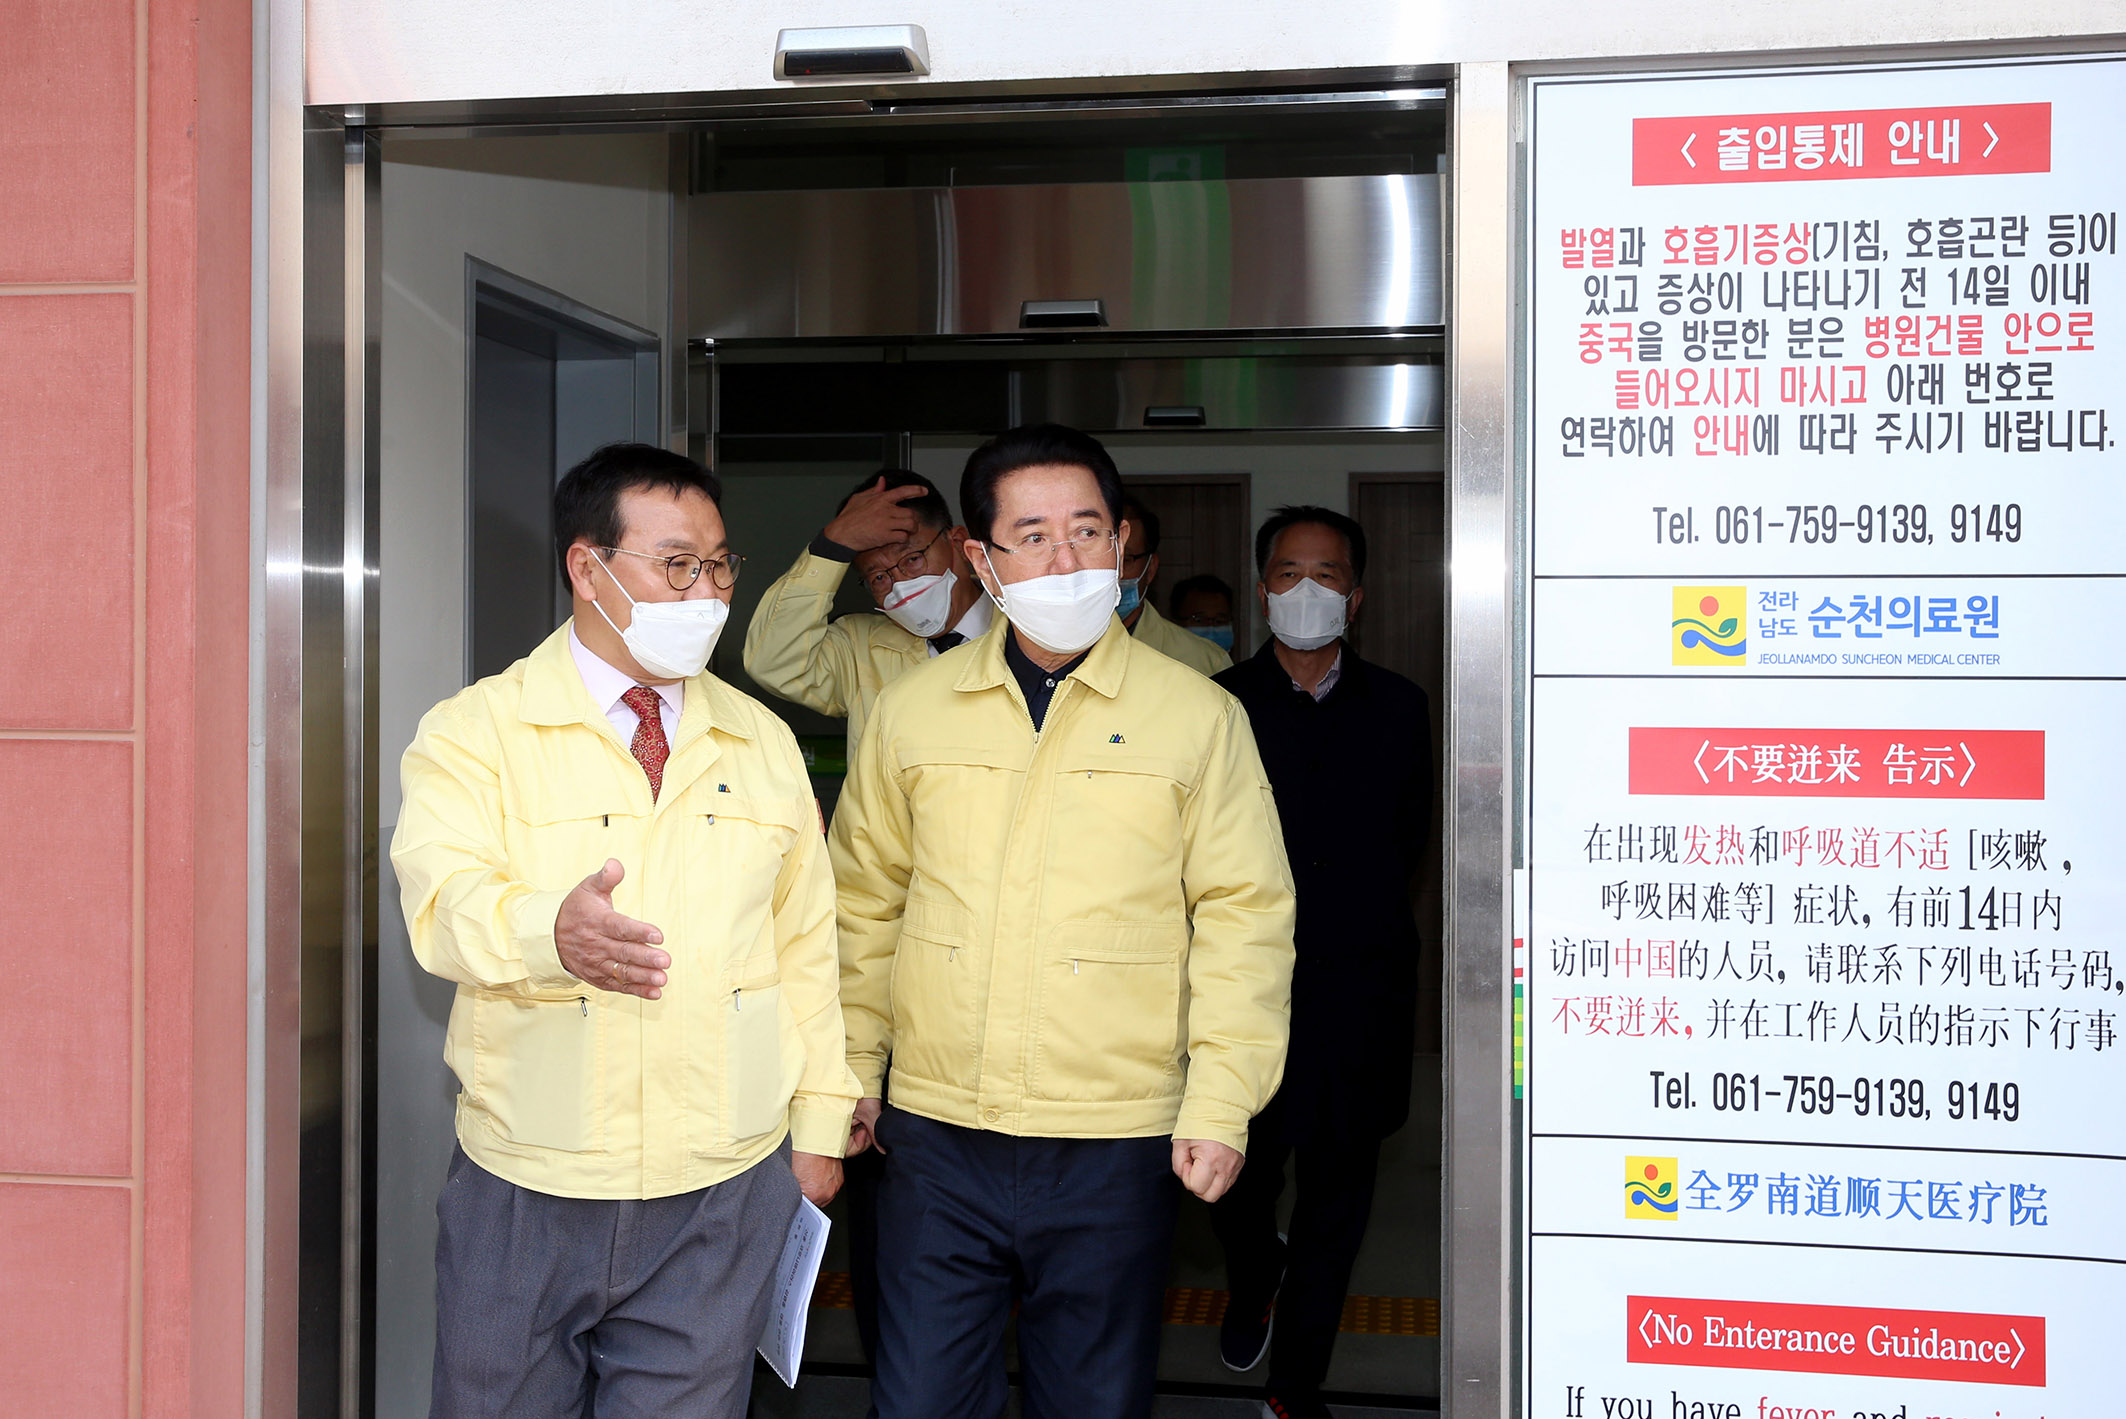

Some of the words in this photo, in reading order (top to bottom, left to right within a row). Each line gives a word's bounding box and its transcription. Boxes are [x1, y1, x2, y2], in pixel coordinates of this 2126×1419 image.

[1717, 122, 1864, 171] 출입통제
[1888, 118, 1960, 165] 안내
[1561, 226, 1646, 269] 발열과
[1905, 214, 2030, 260] 호흡곤란
[1584, 275, 1638, 316] 있고
[1658, 272, 1742, 315] 증상이
[1764, 268, 1879, 312] 나타나기
[1900, 267, 1925, 308] 전
[1948, 265, 2009, 306] 14일
[2031, 262, 2089, 305] 이내
[1579, 321, 1663, 364] 중국을
[1683, 319, 1769, 362] 방문한
[1788, 317, 1844, 358] 분은
[1865, 315, 1983, 358] 병원건물
[2004, 312, 2094, 352] 안으로
[1615, 367, 1759, 409] 들어오시지
[1781, 366, 1866, 407] 마시고
[1887, 363, 1943, 405] 아래
[1966, 362, 2053, 404] 번호로
[1561, 416, 1673, 457] 연락하여
[1694, 415, 1779, 456] 안내에
[1800, 413, 1857, 454] 따라
[1876, 412, 1963, 454] 주시기
[1985, 409, 2114, 452] 바랍니다.
[1653, 507, 1699, 545] Tel.
[1716, 504, 1934, 546] 061-759-9139,
[1950, 503, 2022, 544] 9149
[1758, 590, 1800, 612] 전라
[1807, 594, 2000, 639] 순천의료원
[1758, 617, 1798, 639] 남도
[1758, 653, 1837, 665] JEOLLANAMDO
[1842, 653, 1902, 665] SUNCHEON
[1907, 653, 1955, 665] MEDICAL
[1957, 653, 2001, 666] CENTER
[1650, 1071, 1697, 1110] Tel.
[1712, 1072, 1931, 1121] 061-759-9139,
[1947, 1080, 2020, 1123] 9149
[1685, 1169, 2049, 1227] 全罗南道顺天医疗院
[1703, 1316, 1856, 1355] Enterance
[1566, 1385, 1585, 1418] If
[1600, 1396, 1653, 1419] you
[1670, 1390, 1742, 1419] have
